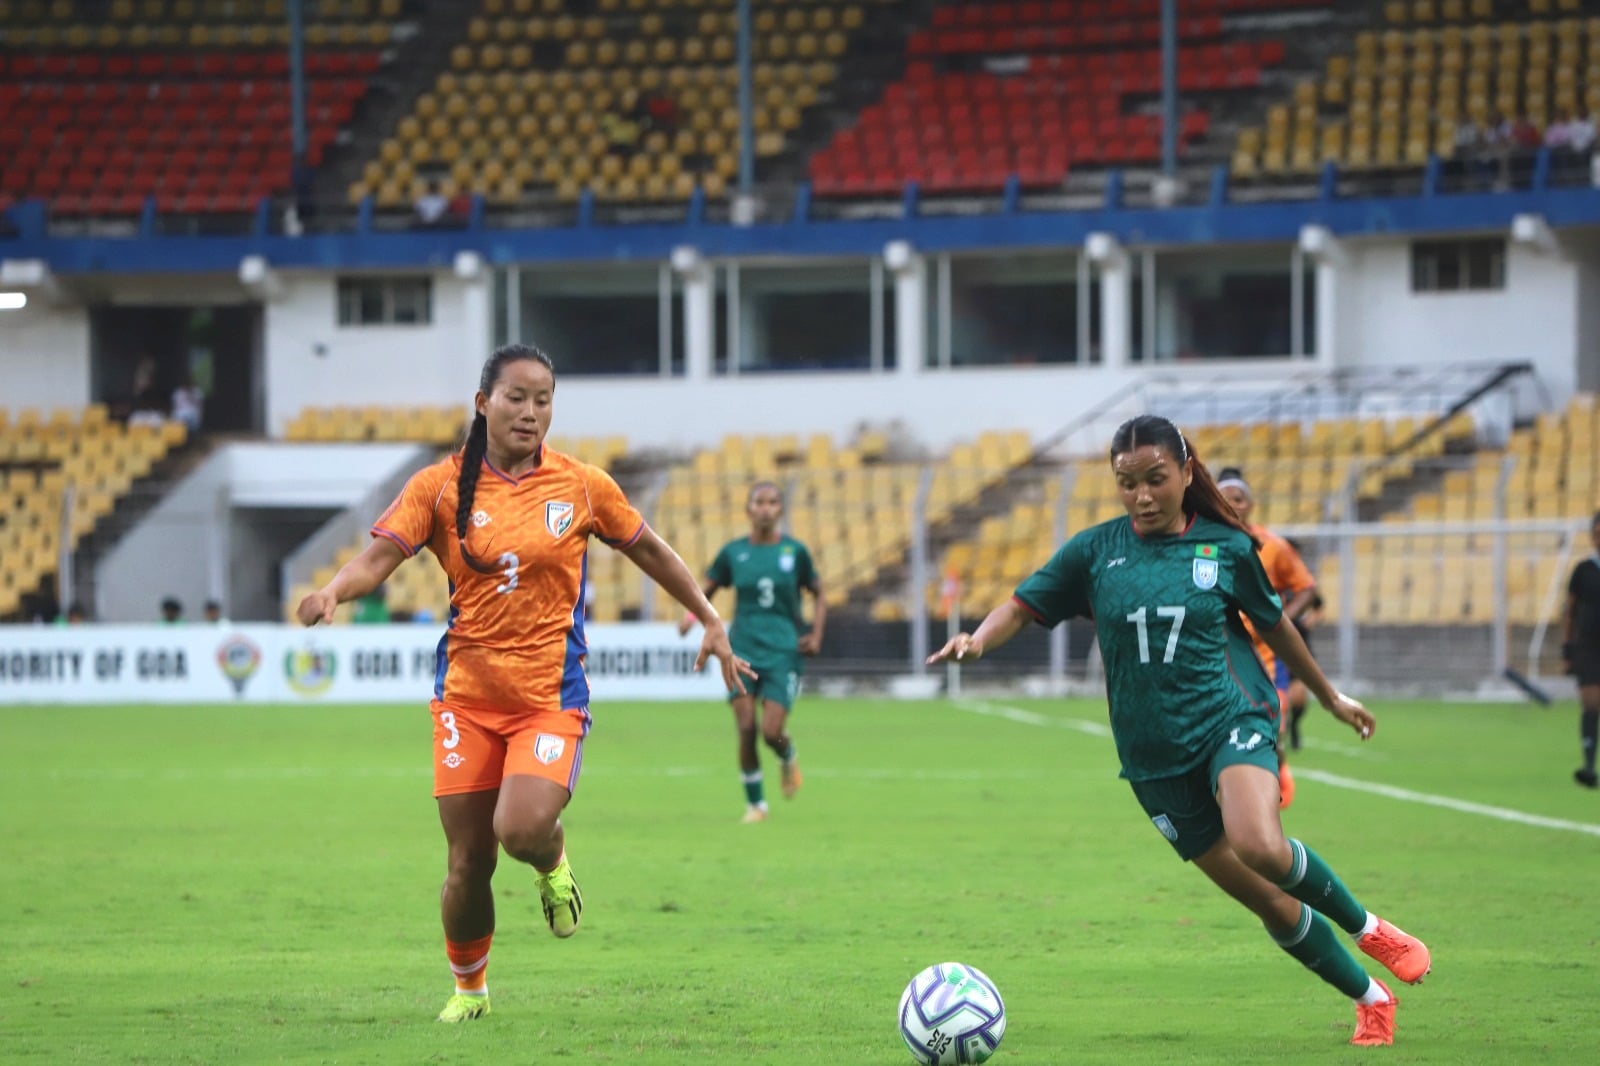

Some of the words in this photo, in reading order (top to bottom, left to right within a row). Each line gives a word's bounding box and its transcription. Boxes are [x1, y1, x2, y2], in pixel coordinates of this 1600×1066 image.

[496, 551, 520, 595] 3
[757, 577, 775, 608] 3
[1126, 605, 1186, 664] 17
[95, 650, 124, 680] OF
[136, 650, 188, 680] GOA
[353, 650, 402, 678] GOA
[440, 711, 460, 749] 3
